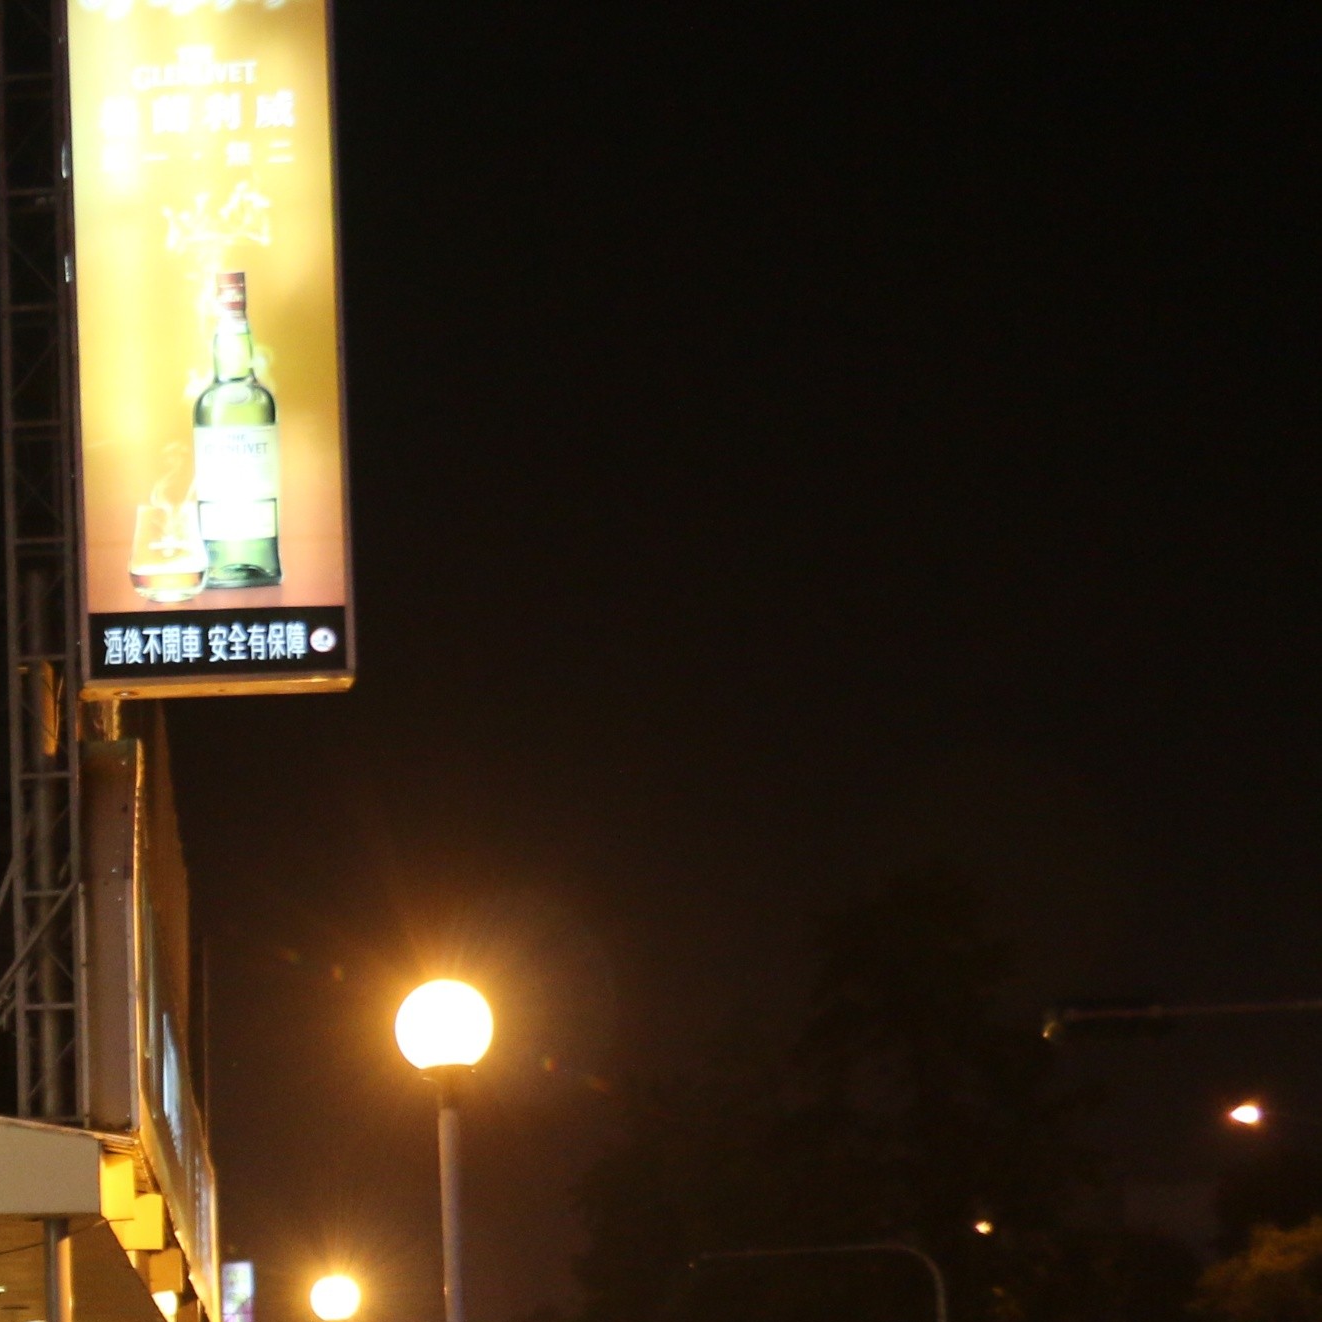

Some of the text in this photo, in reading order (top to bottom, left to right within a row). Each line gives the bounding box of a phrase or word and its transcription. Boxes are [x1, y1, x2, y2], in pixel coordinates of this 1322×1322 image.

[104, 622, 307, 665] 酒後不開車 安全有保障
